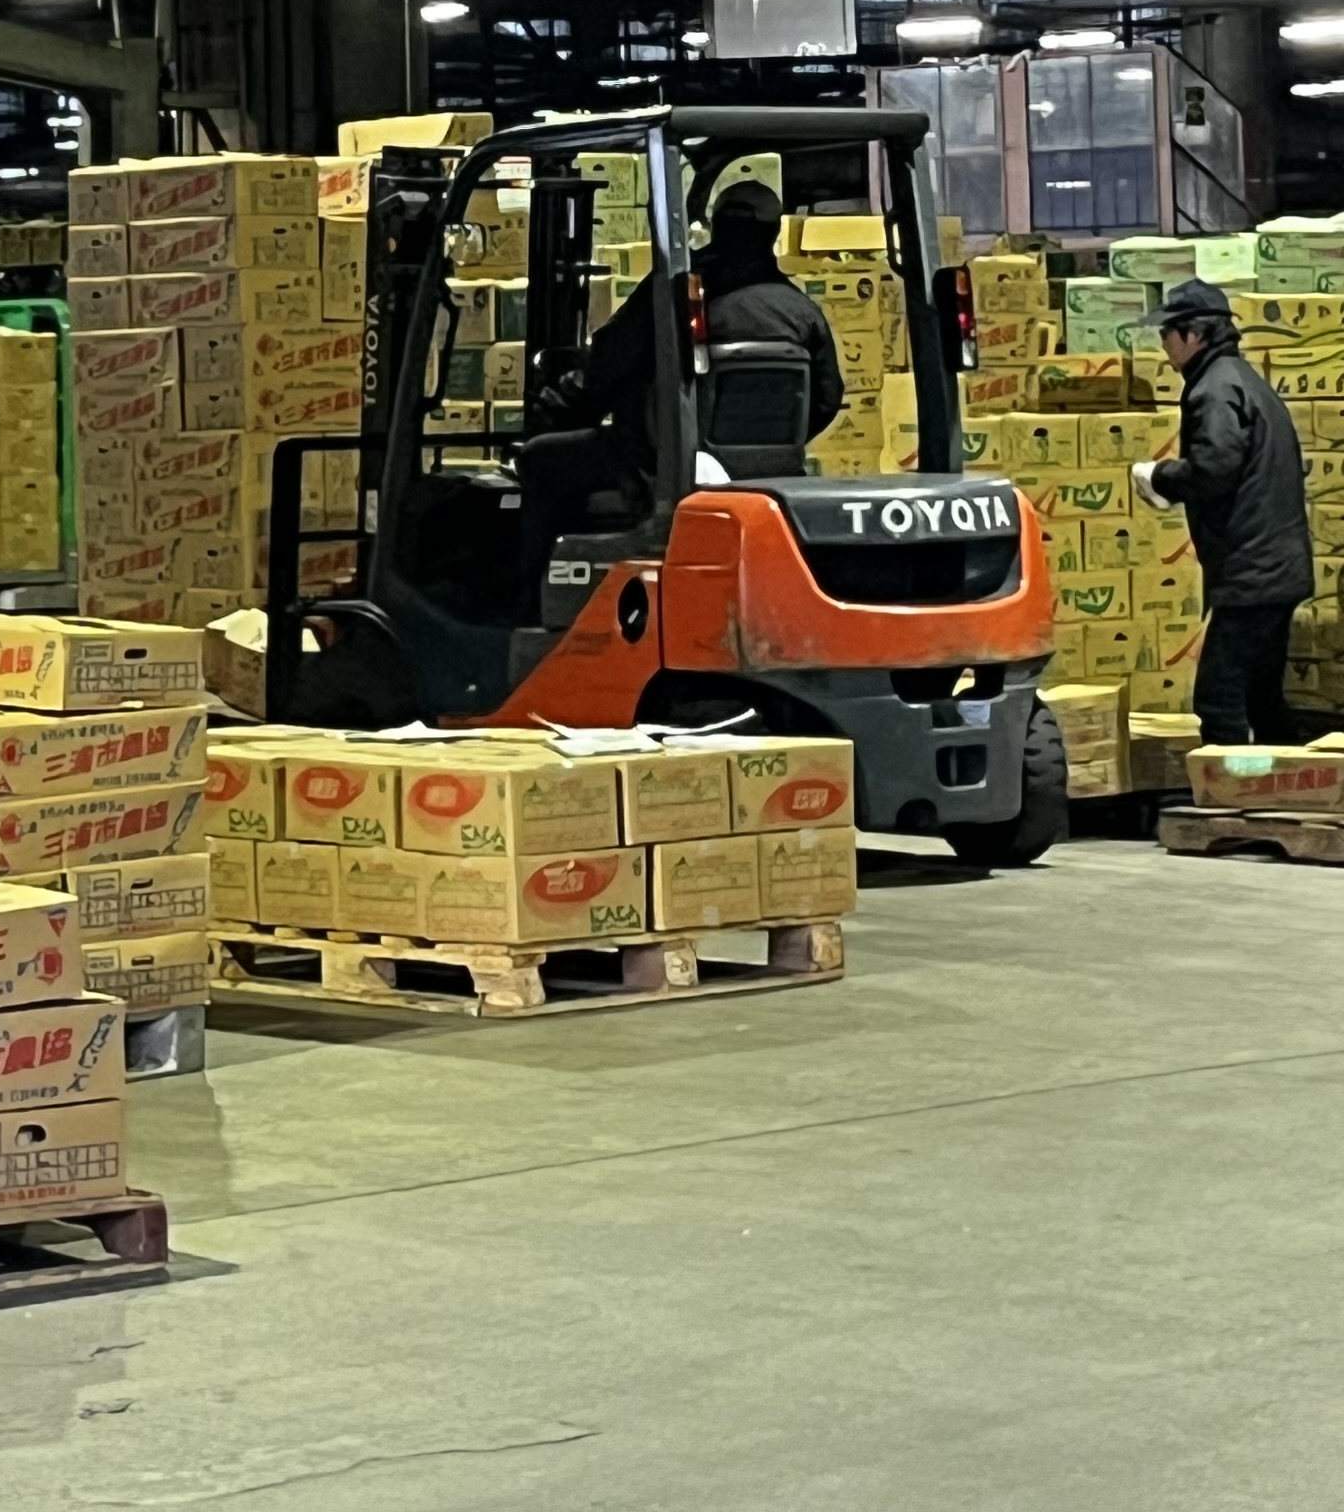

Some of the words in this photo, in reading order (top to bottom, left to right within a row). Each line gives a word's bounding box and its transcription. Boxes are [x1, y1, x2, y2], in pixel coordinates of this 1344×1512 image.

[364, 295, 379, 404] TOYOTA
[842, 497, 1011, 534] TOYOTA
[549, 561, 591, 585] 20
